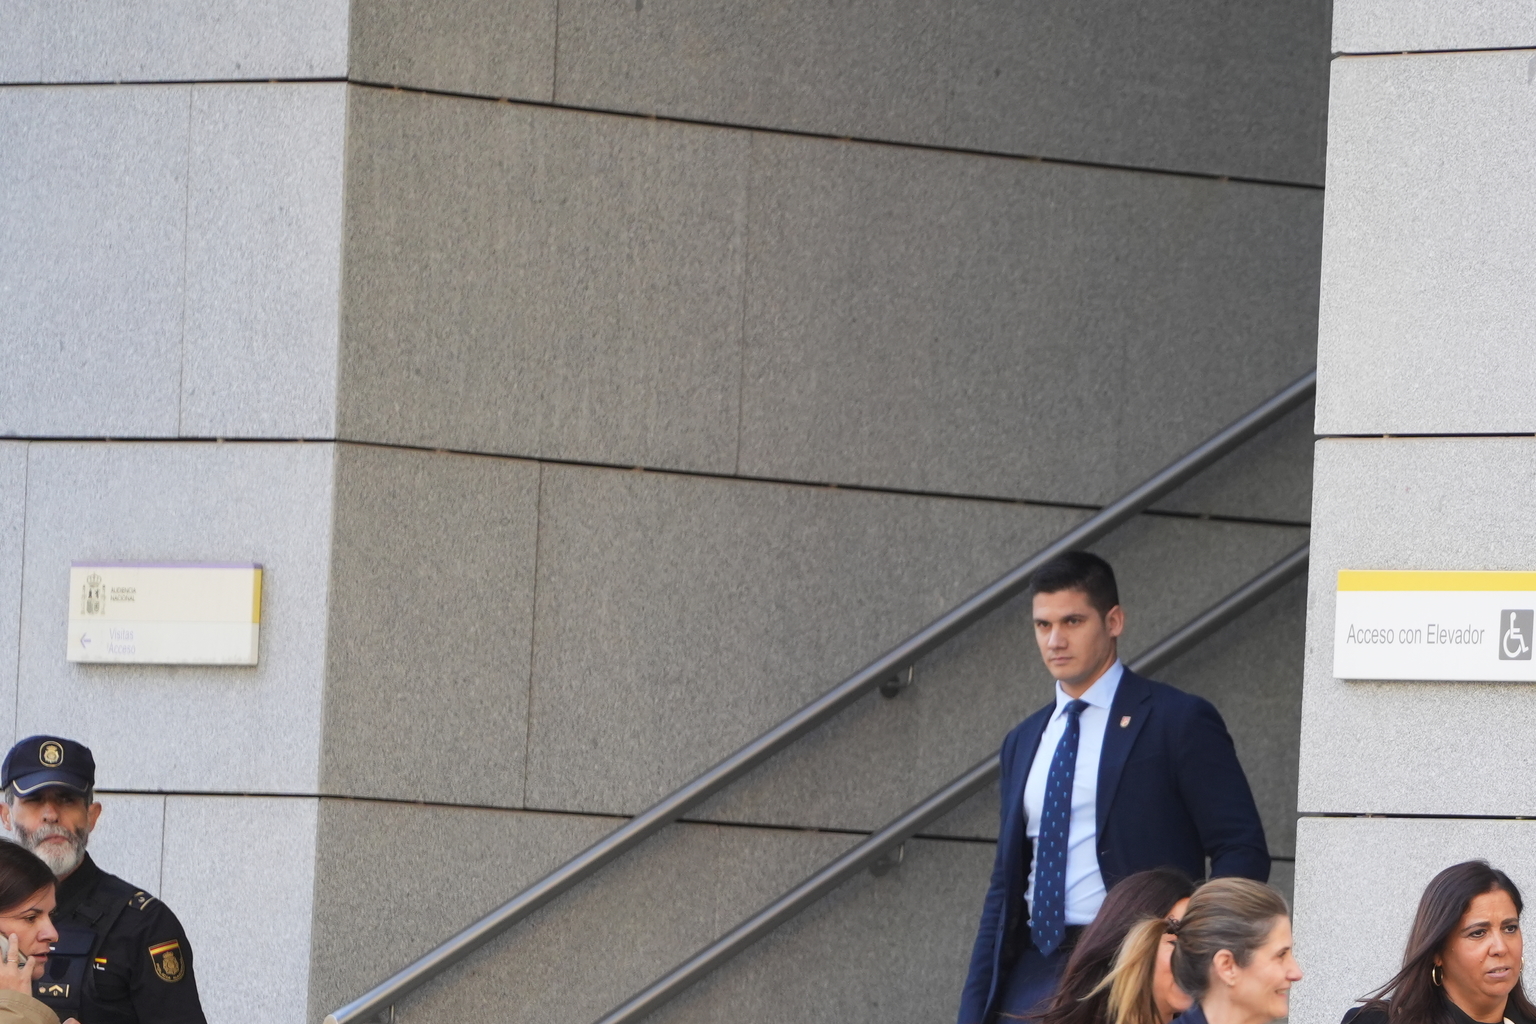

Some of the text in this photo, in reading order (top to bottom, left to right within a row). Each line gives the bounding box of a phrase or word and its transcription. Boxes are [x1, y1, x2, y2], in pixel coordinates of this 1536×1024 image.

[109, 628, 134, 640] Visitas
[1346, 624, 1485, 645] Acceso con Elevador
[108, 642, 136, 654] Acceso
